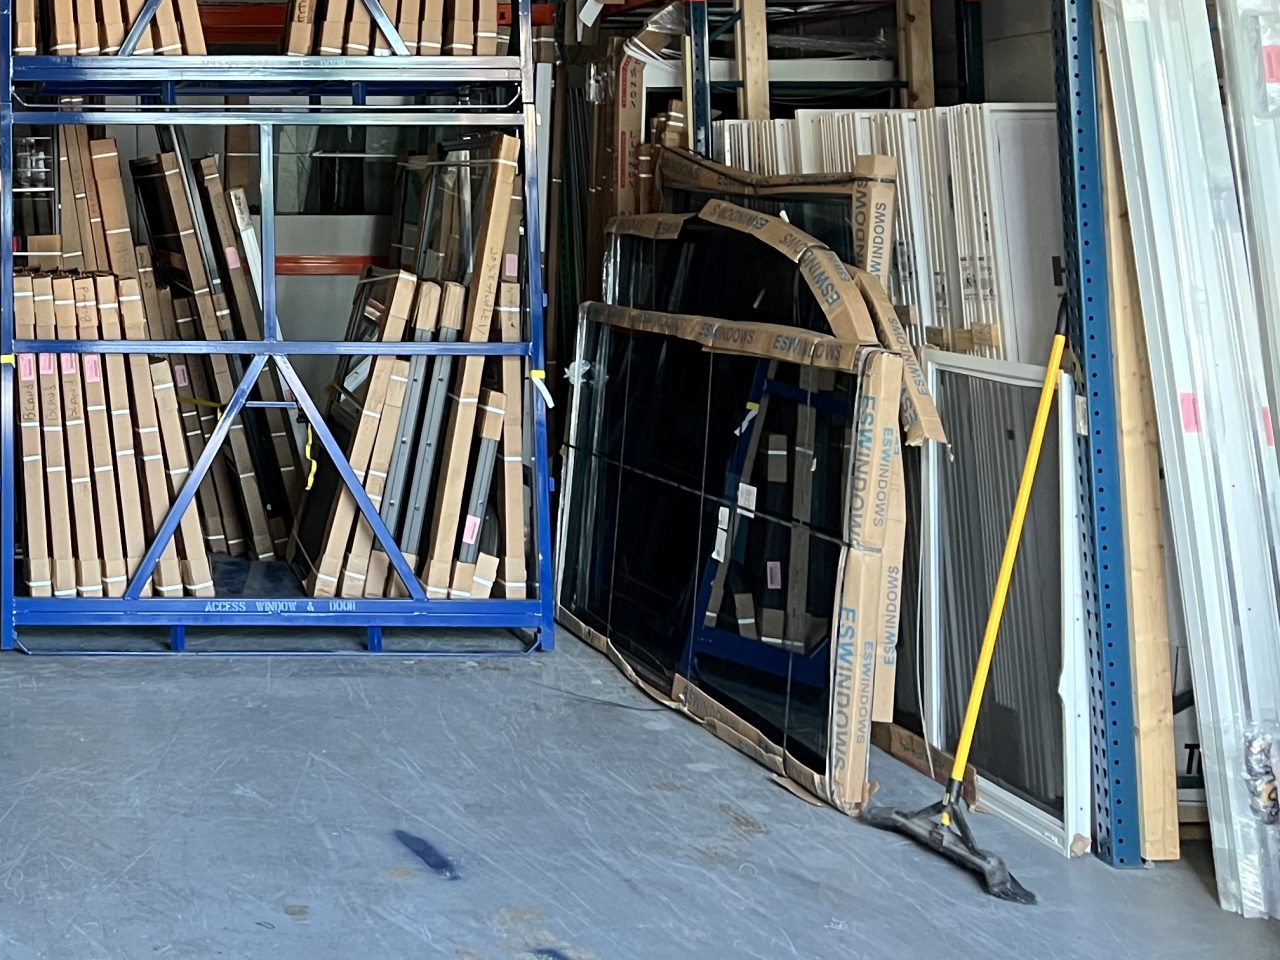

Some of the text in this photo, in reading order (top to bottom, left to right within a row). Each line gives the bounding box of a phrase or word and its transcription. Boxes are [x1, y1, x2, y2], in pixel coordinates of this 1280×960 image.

[874, 427, 894, 527] ESWINDOWS
[205, 601, 246, 612] ACCESS
[256, 601, 297, 612] WINDOW
[329, 600, 356, 611] DOOR
[884, 565, 900, 666] ESWINDOWS
[832, 607, 856, 771] ESWINDOWS
[857, 641, 873, 745] ESWINDOWS
